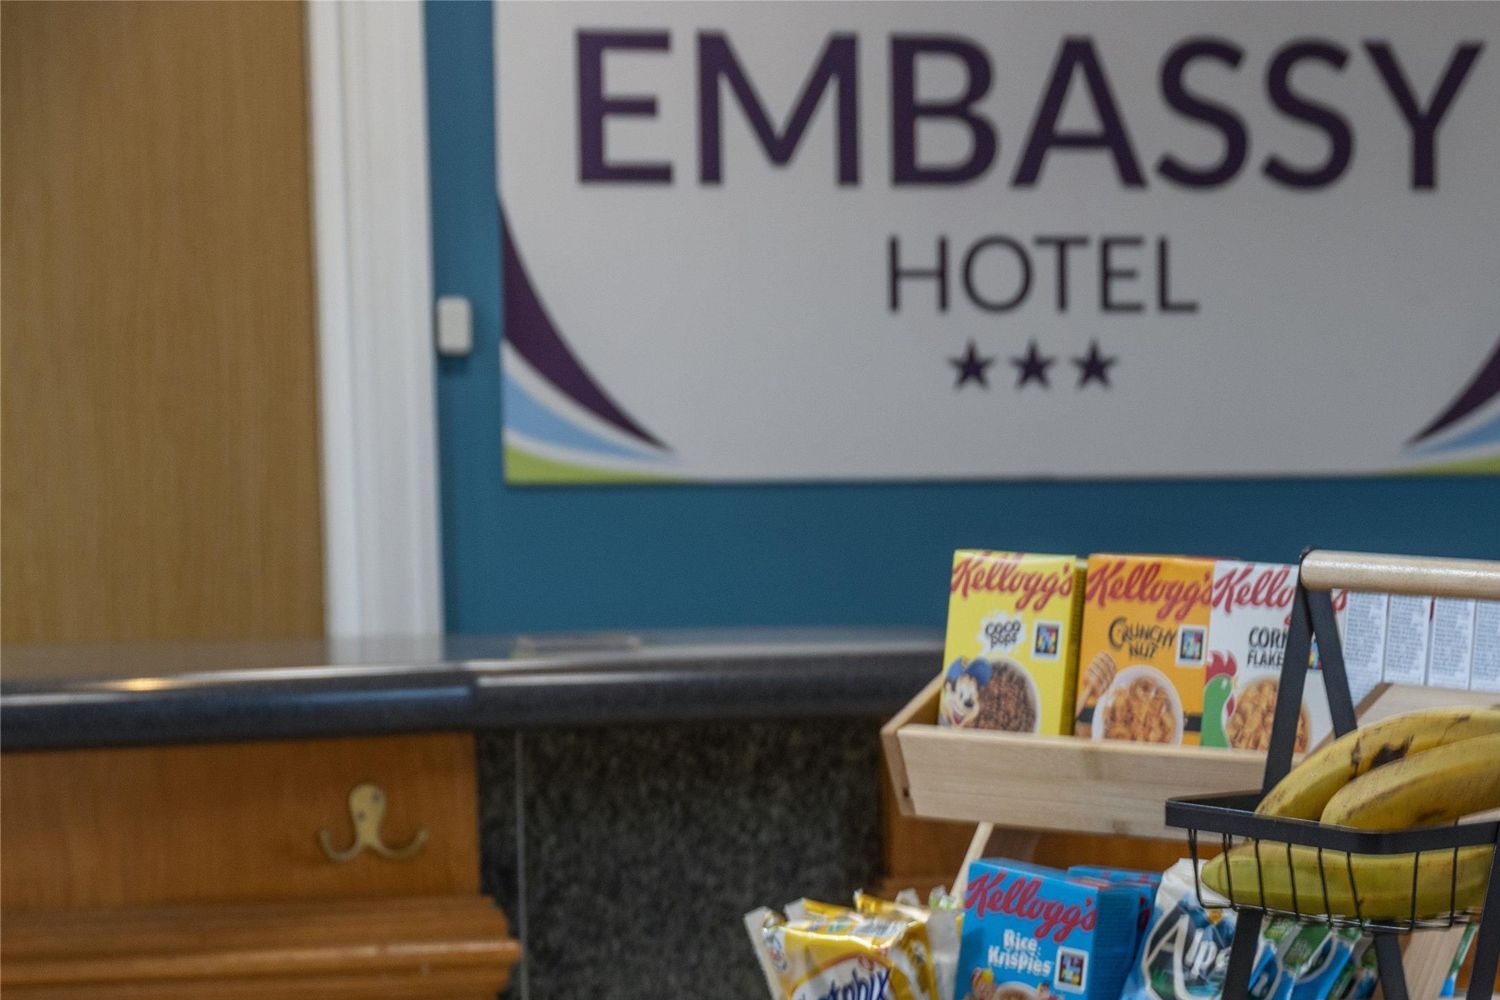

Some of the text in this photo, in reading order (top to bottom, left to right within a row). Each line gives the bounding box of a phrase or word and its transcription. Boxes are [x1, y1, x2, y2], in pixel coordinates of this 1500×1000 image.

[576, 29, 1485, 190] EMBASSY
[888, 235, 1199, 312] HOTEL
[951, 556, 1073, 612] Kellogg's
[1086, 559, 1213, 622] Kellogg's
[1247, 650, 1286, 666] FLAKE
[964, 870, 1098, 943] Kellogg's
[1003, 928, 1038, 952] Rice
